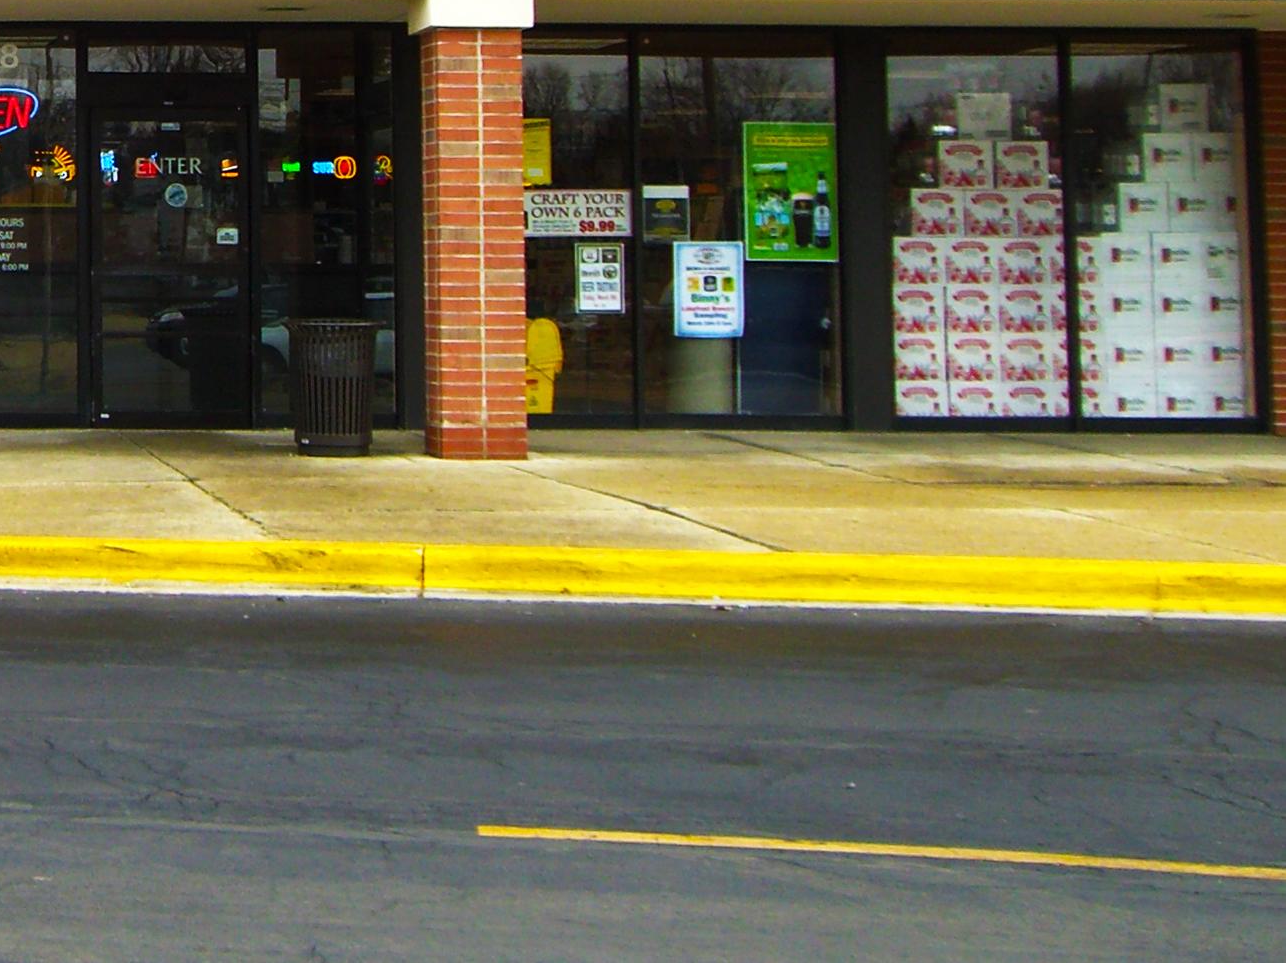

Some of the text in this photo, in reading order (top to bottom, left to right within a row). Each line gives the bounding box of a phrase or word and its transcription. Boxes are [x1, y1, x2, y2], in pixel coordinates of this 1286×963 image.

[136, 157, 202, 174] ENTER
[531, 194, 625, 205] CRAFT YOUR
[531, 207, 625, 218] OWN 6 PACK
[579, 220, 615, 233] $9.99
